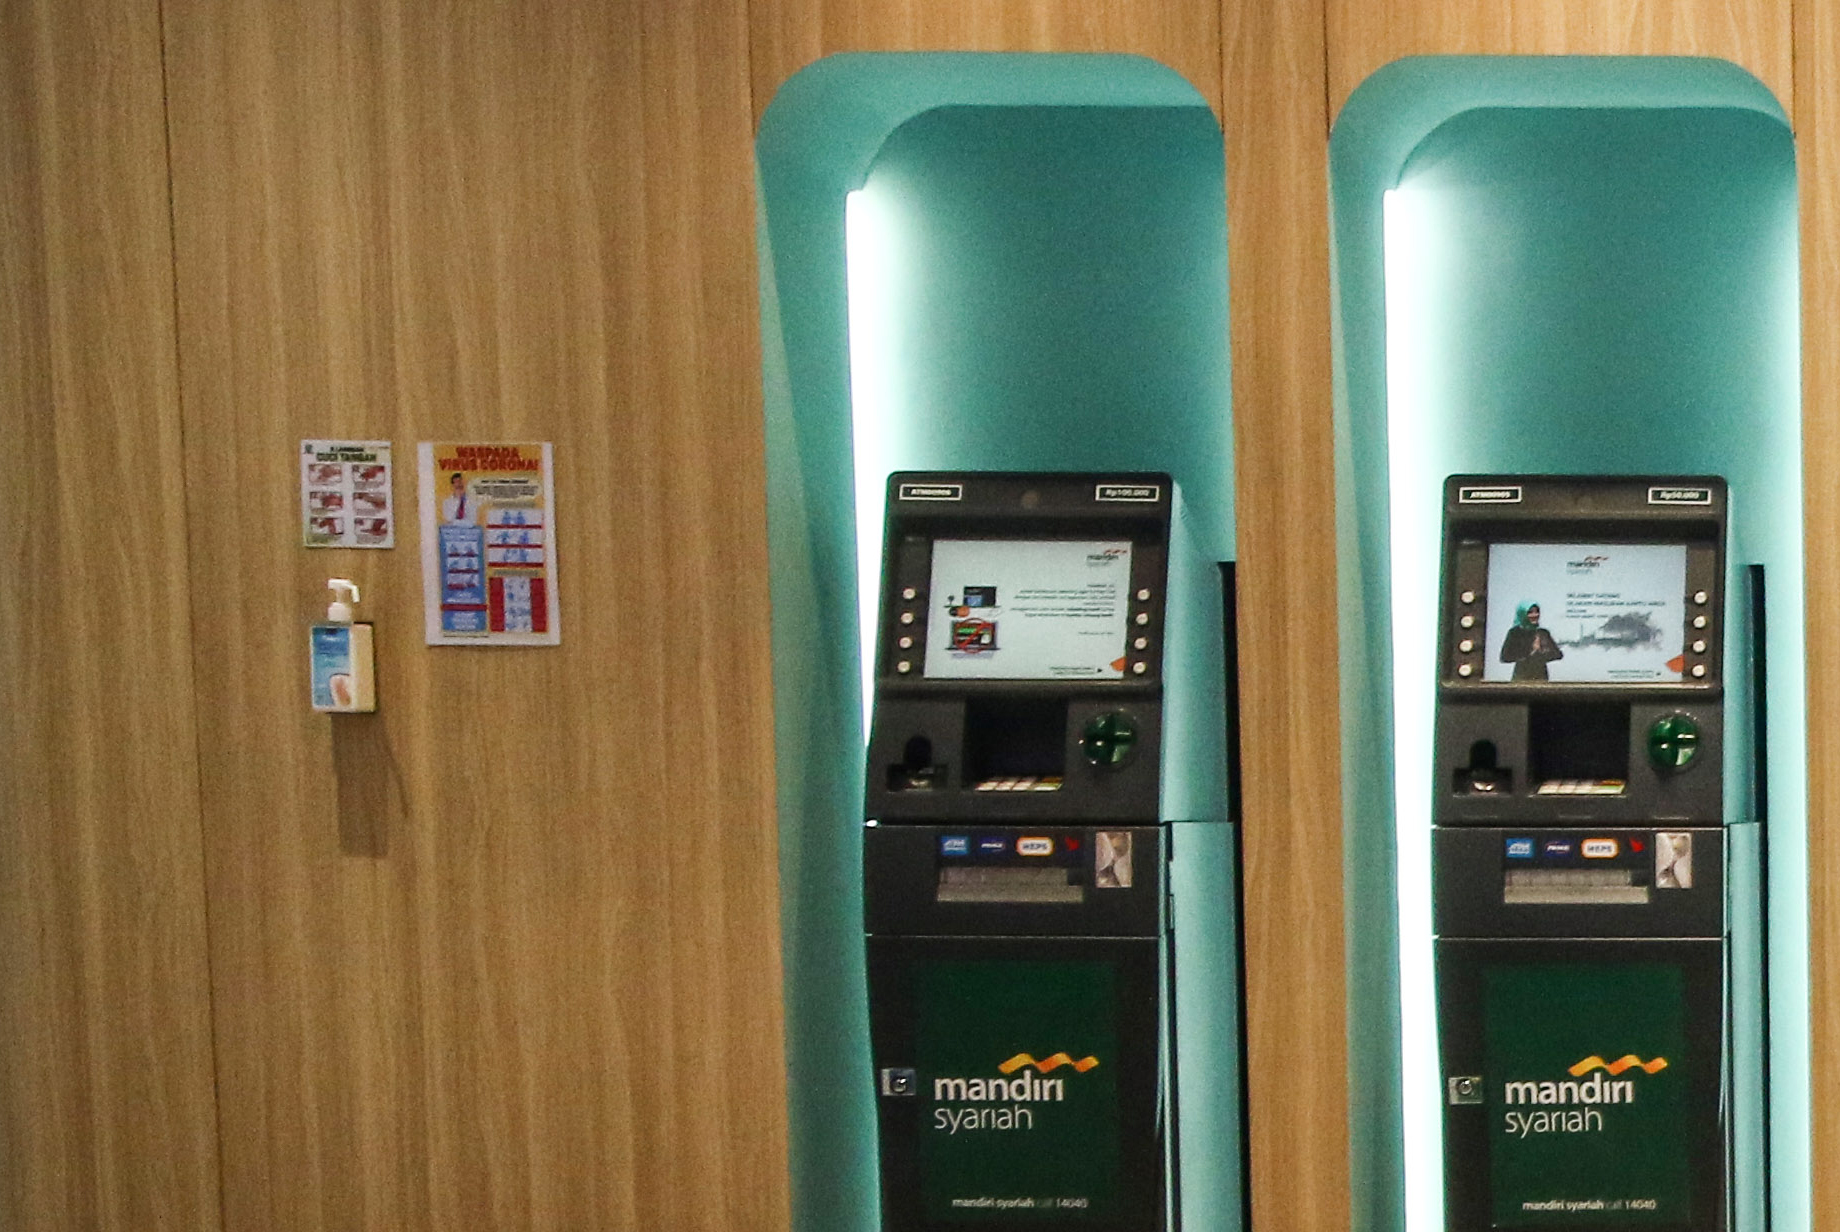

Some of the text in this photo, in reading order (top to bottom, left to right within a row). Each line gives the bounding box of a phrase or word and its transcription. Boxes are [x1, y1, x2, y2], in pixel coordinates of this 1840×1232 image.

[438, 458, 478, 471] VIRUS
[935, 1070, 1063, 1101] mandiri
[1505, 1072, 1633, 1104] mandiri
[935, 1105, 1032, 1134] syariah
[1505, 1108, 1602, 1138] syariah
[952, 1197, 995, 1208] mandiri
[996, 1197, 1034, 1209] syariah
[1523, 1200, 1565, 1210] mandiri
[1566, 1200, 1604, 1212] syariah
